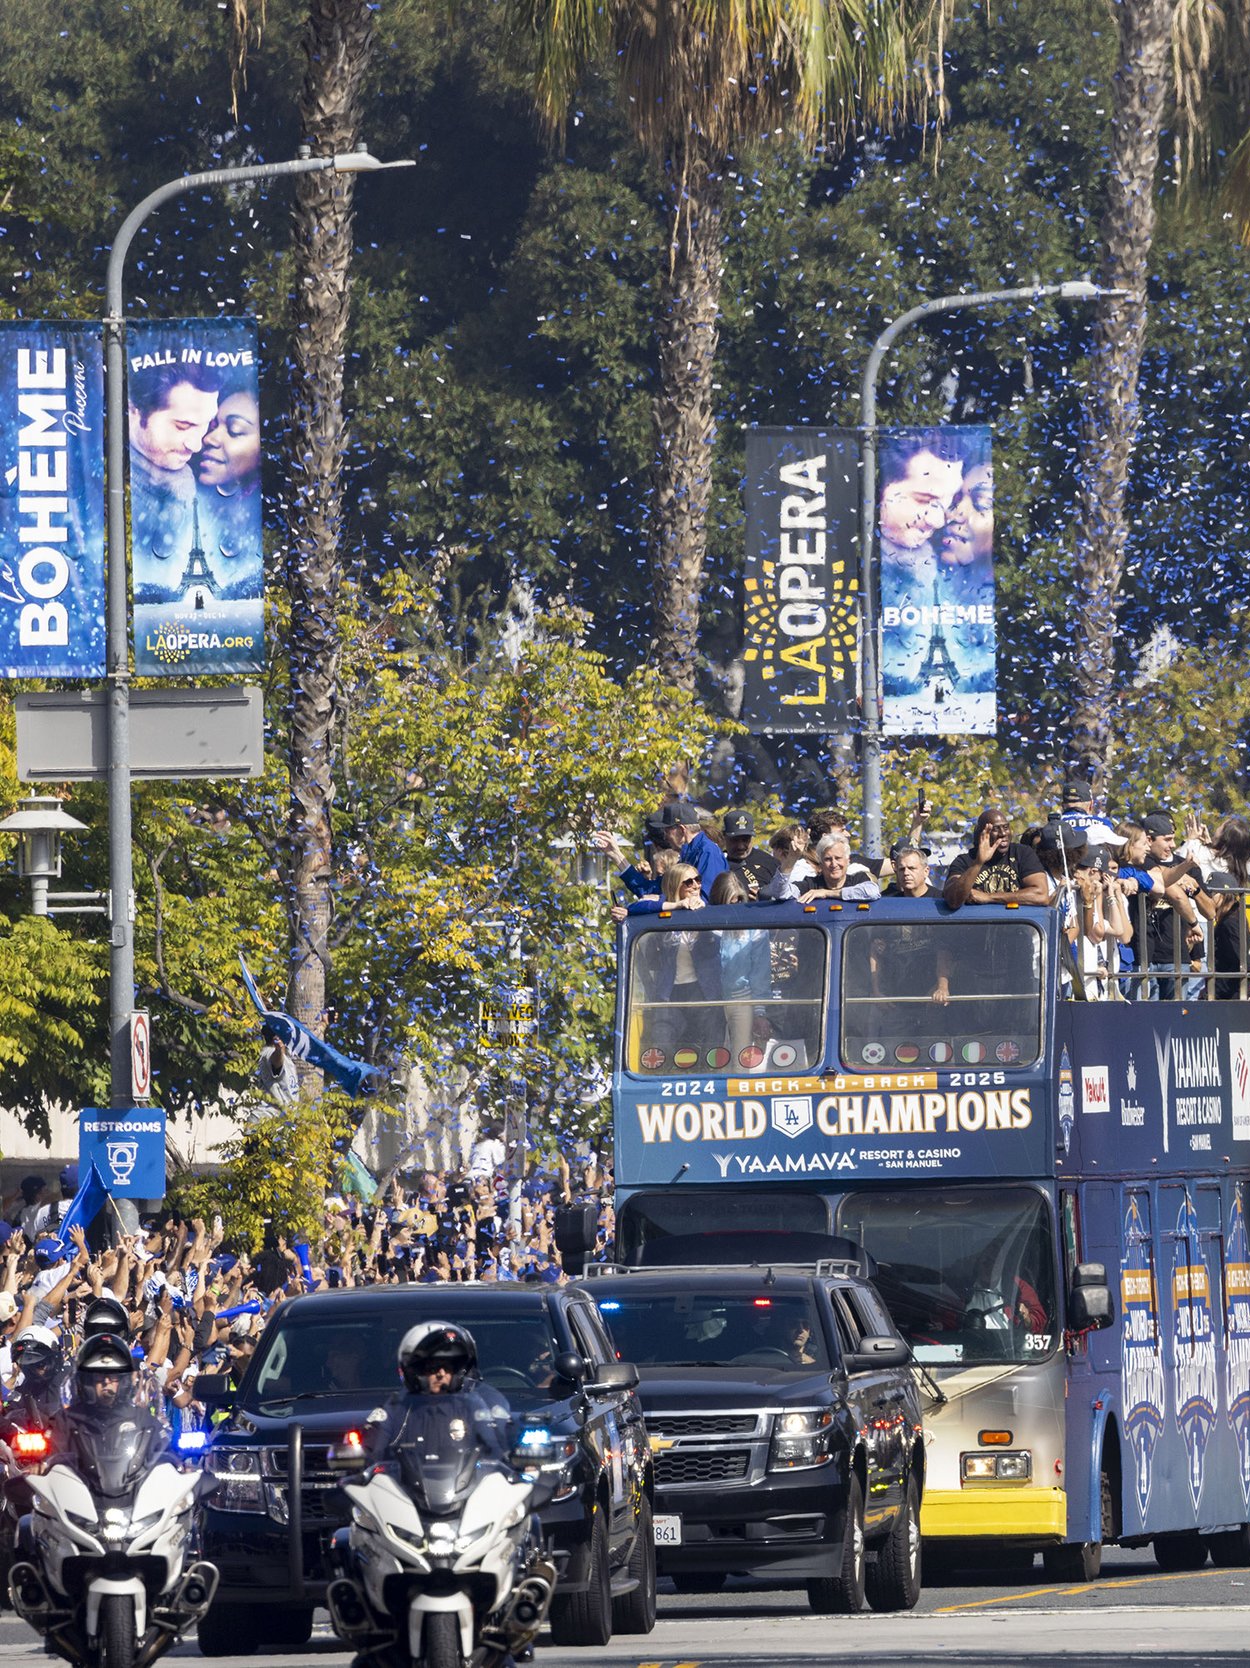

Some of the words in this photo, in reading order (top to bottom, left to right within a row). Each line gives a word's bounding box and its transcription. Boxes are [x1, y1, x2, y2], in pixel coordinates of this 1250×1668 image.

[131, 350, 177, 373] FALL
[181, 348, 202, 364] IN
[206, 350, 254, 367] LOVE
[5, 348, 70, 646] BOHÈME
[661, 1081, 716, 1097] 2024
[738, 1075, 926, 1093] BACK-TO-BACK
[950, 1071, 1007, 1087] 2025
[1085, 1077, 1106, 1104] Yakult
[636, 1099, 768, 1144] WORLD
[784, 1104, 800, 1126] LA
[816, 1088, 1033, 1136] CHAMPIONS
[84, 1121, 162, 1133] RESTROOMS
[859, 1150, 903, 1160] RESORT
[907, 1149, 915, 1159] &
[917, 1148, 962, 1159] CASINO
[885, 1160, 903, 1168] SAN
[905, 1159, 943, 1168] MANUEL
[1025, 1333, 1052, 1350] 357
[655, 1526, 677, 1541] 861
